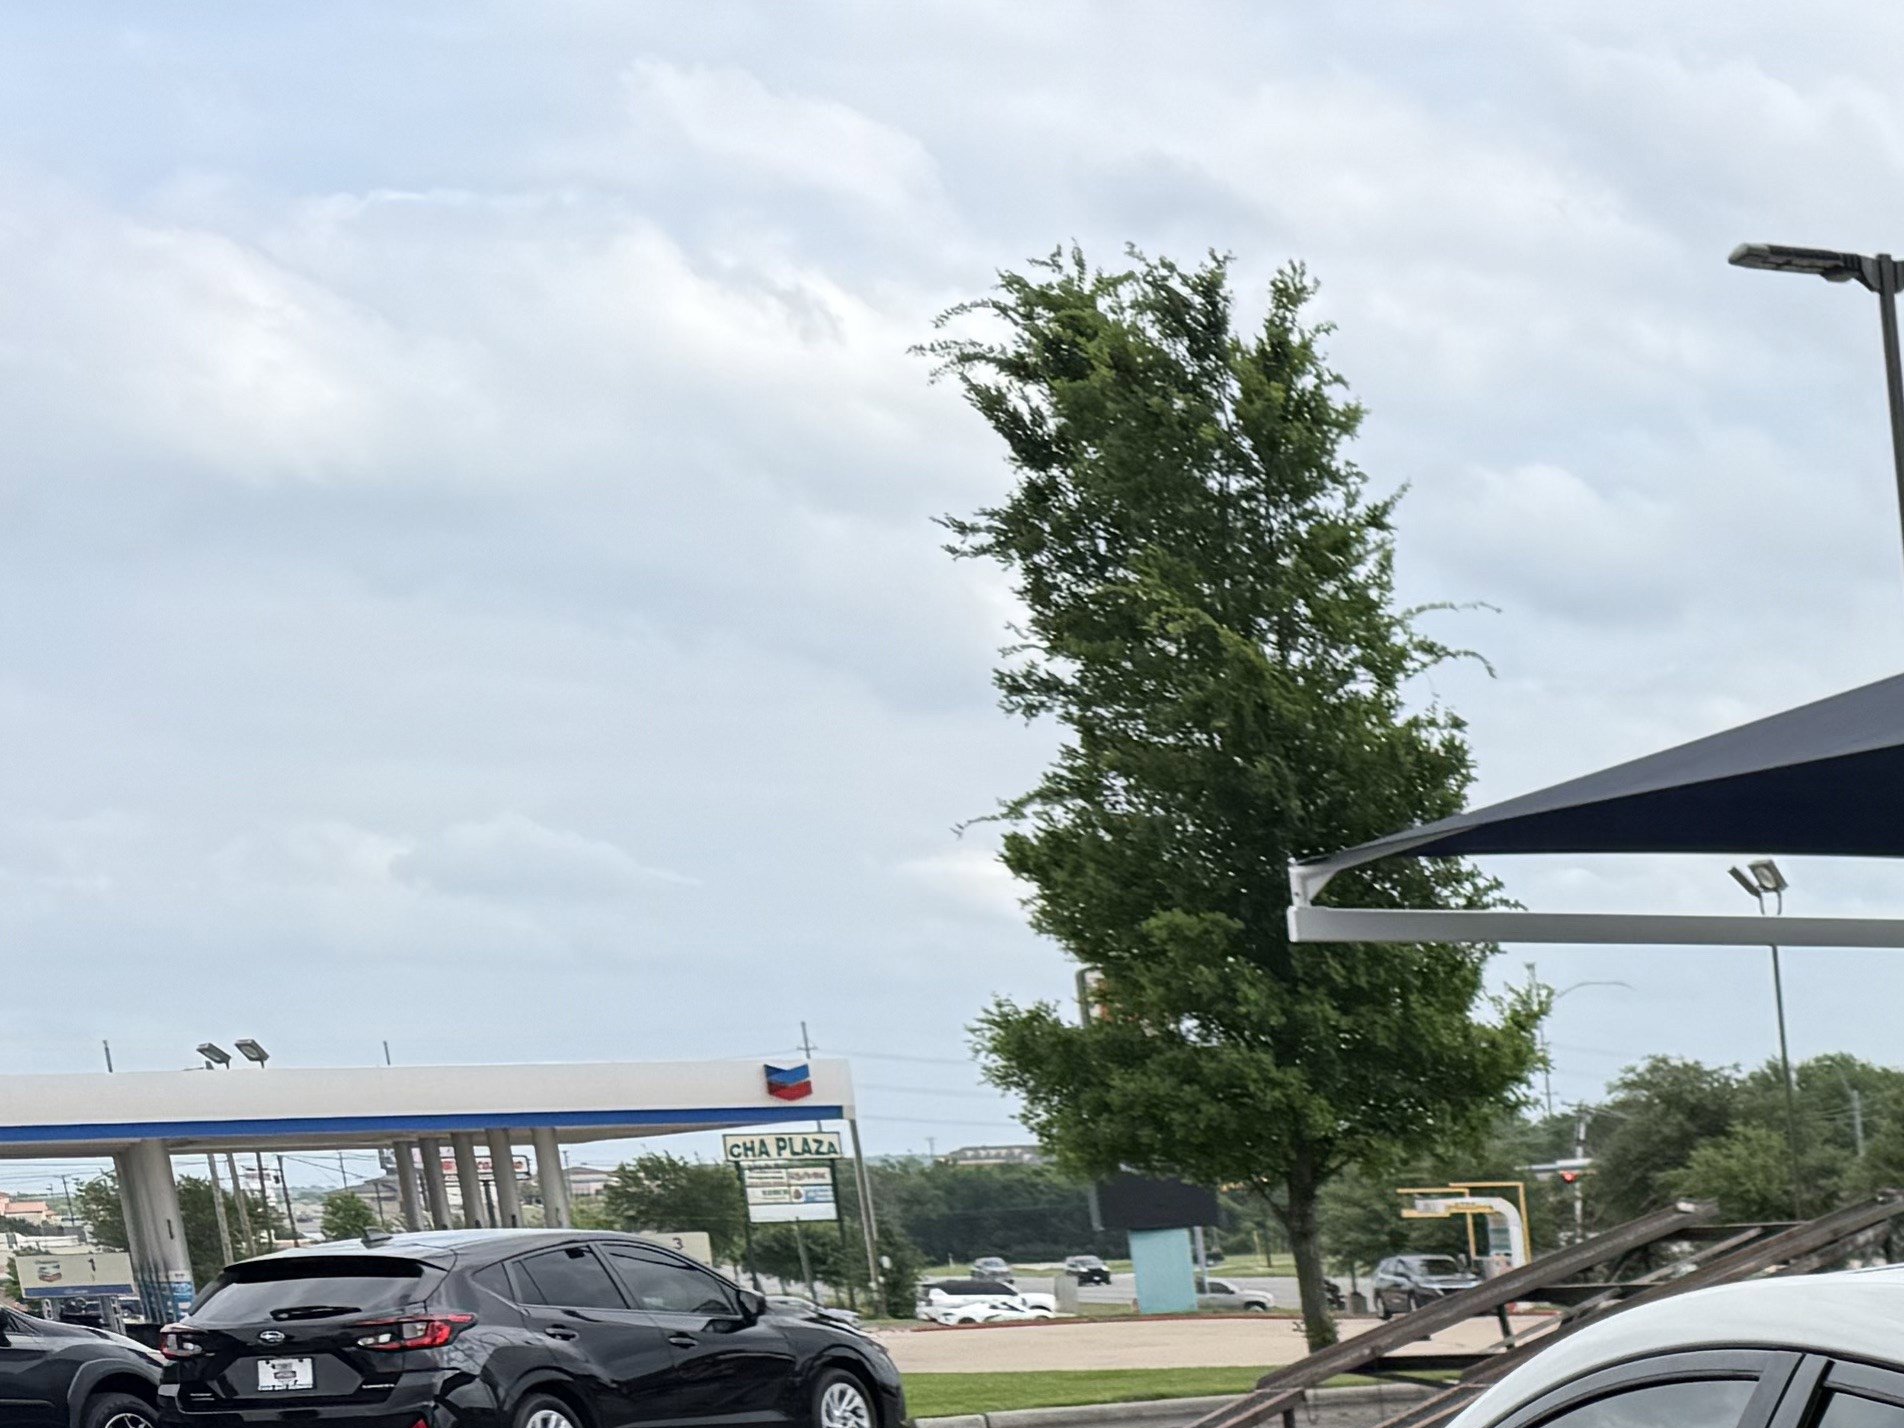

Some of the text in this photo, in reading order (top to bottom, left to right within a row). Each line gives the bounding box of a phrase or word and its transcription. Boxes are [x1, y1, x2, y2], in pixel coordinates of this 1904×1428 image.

[729, 1136, 839, 1158] CHA PLAZA
[672, 1237, 684, 1250] 3
